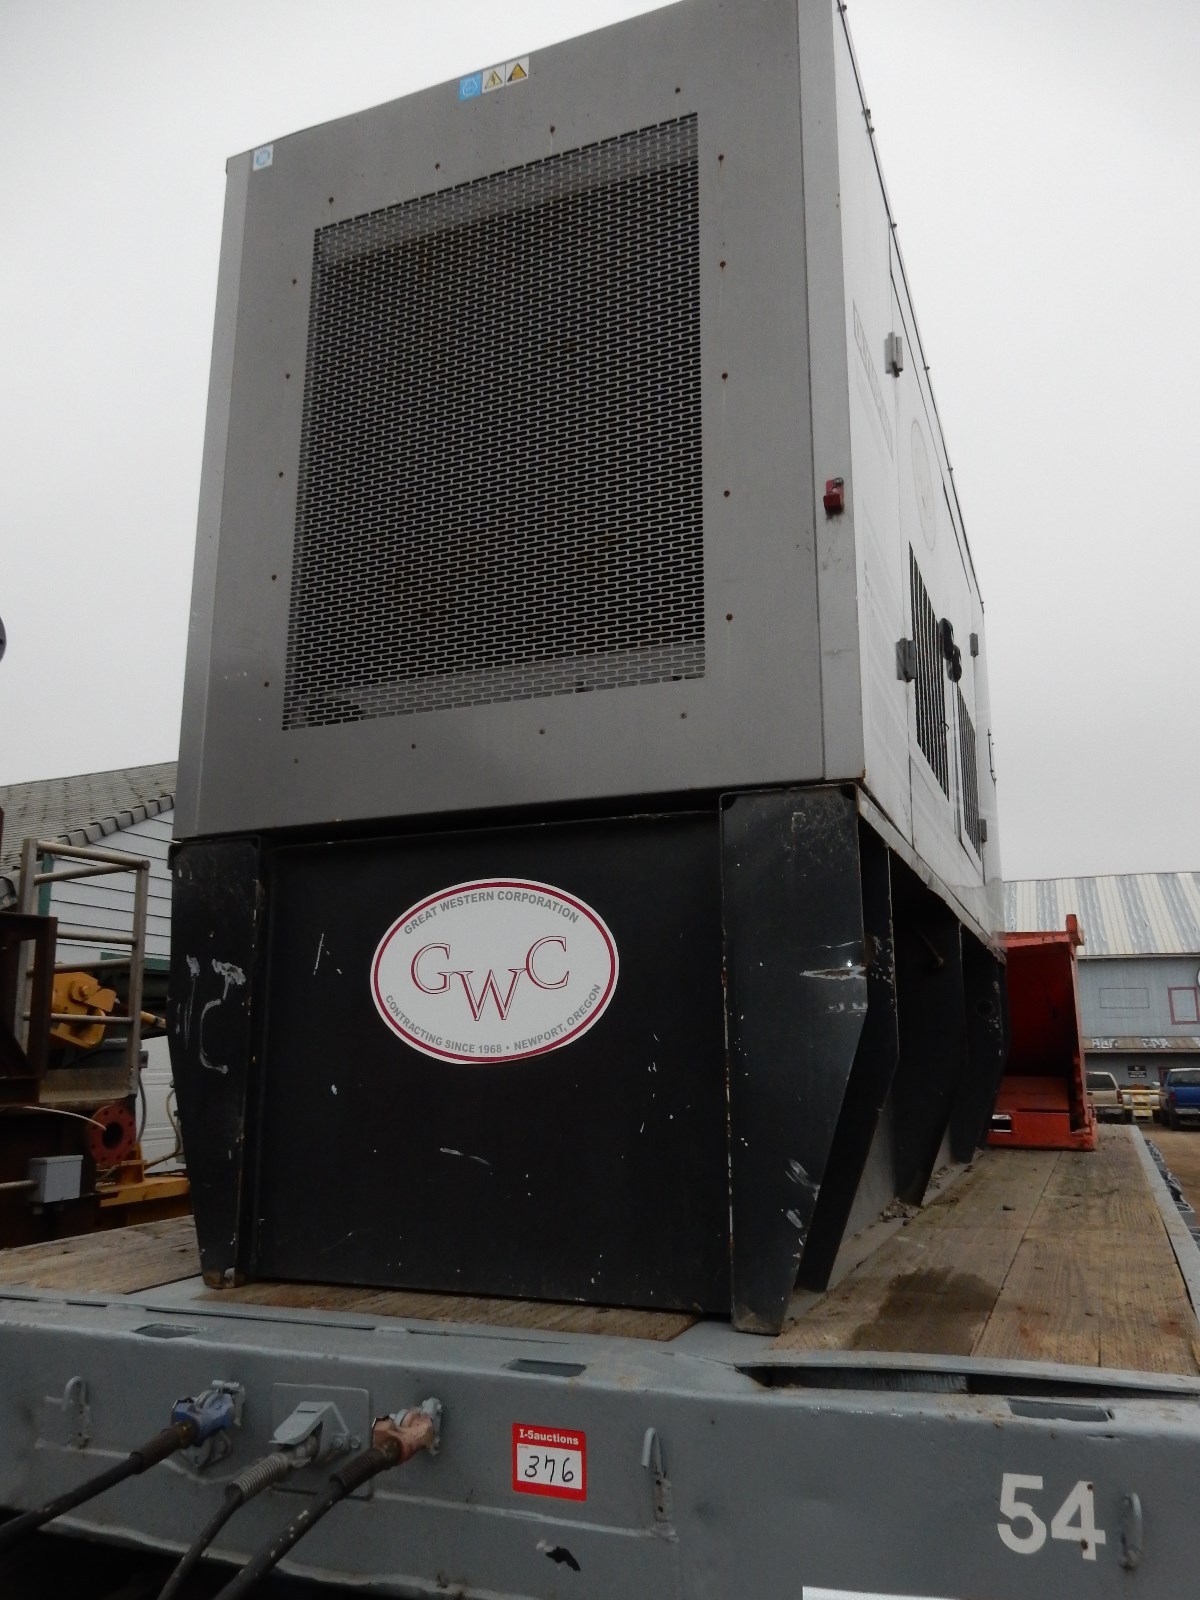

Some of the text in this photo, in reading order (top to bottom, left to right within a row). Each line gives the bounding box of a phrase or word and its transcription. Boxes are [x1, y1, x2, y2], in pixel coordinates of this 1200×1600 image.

[404, 890, 579, 935] GREAT WESTERN CORPORATION
[411, 935, 569, 1022] GWC
[385, 983, 602, 1054] CONTRACTING SINCE 1968 NEWPORT, OREGON
[524, 1454, 574, 1483] 376
[996, 1472, 1107, 1561] 54
